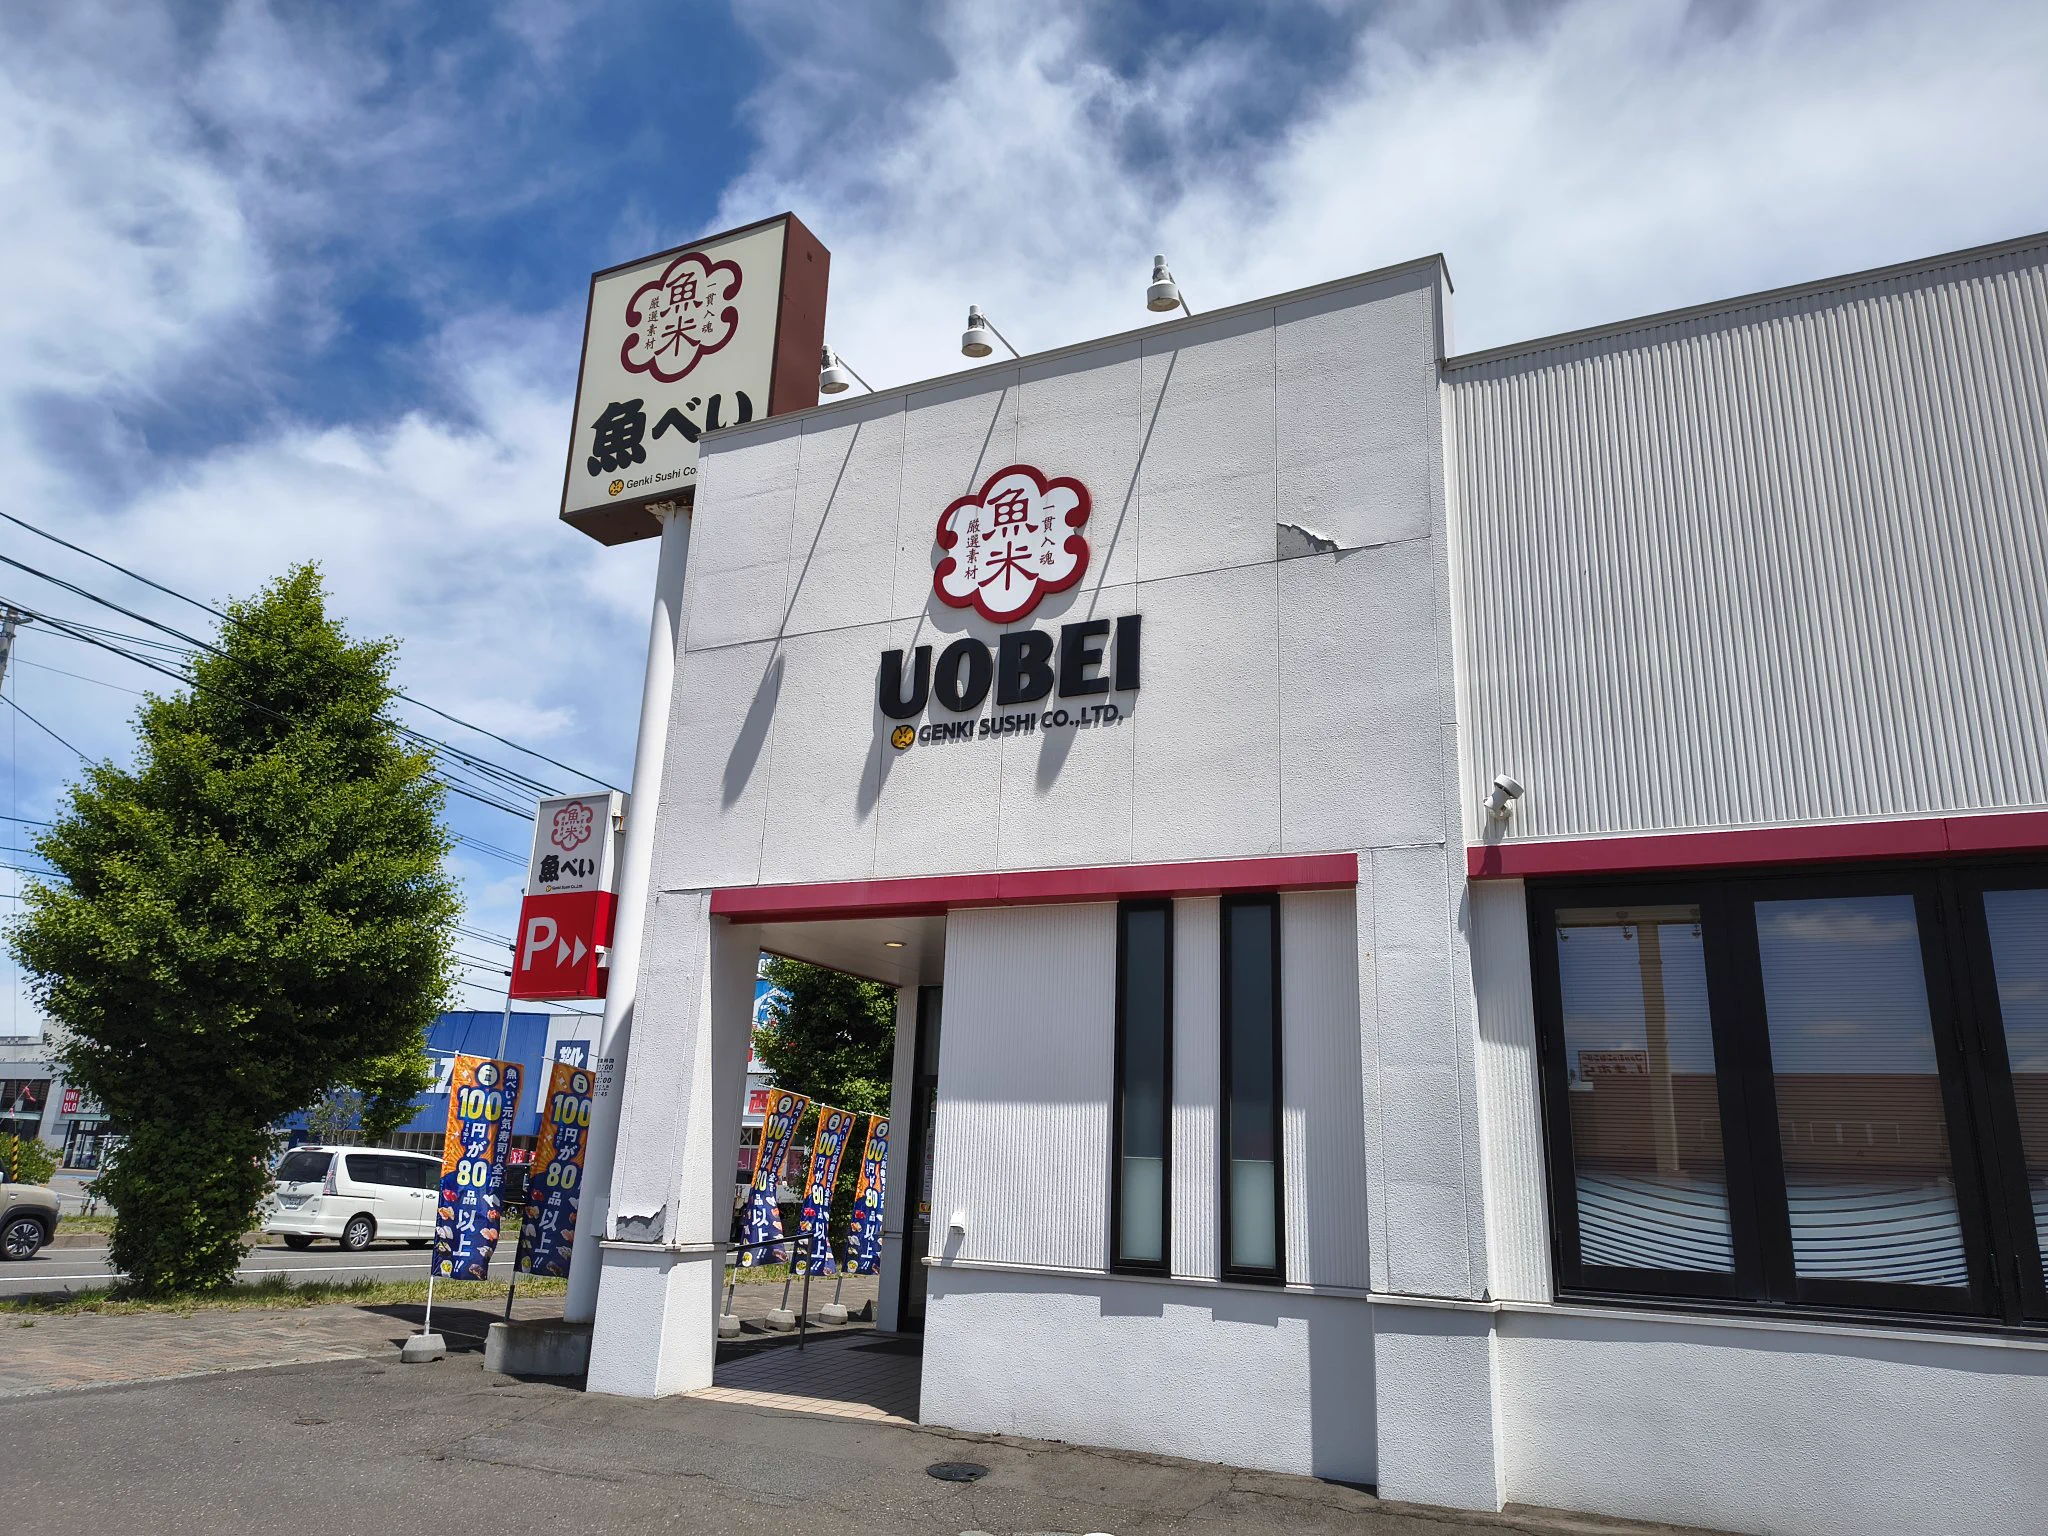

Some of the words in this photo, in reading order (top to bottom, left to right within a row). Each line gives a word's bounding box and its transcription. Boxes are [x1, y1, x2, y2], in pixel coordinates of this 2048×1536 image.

[586, 390, 754, 478] 魚べい
[626, 475, 653, 489] Genki
[655, 468, 681, 483] Sushi
[964, 518, 981, 580] 厳選素材
[1039, 504, 1056, 566] 一貫入魂
[878, 613, 1142, 720] UOBEI
[918, 720, 975, 742] GENKI
[978, 712, 1036, 735] SUSHI
[538, 854, 595, 884] 魚べい
[522, 917, 558, 971] P
[63, 1102, 77, 1113] QLO
[459, 1087, 502, 1121] 100
[554, 1094, 592, 1127] 100
[456, 1160, 488, 1187] 80
[546, 1162, 577, 1190] 80
